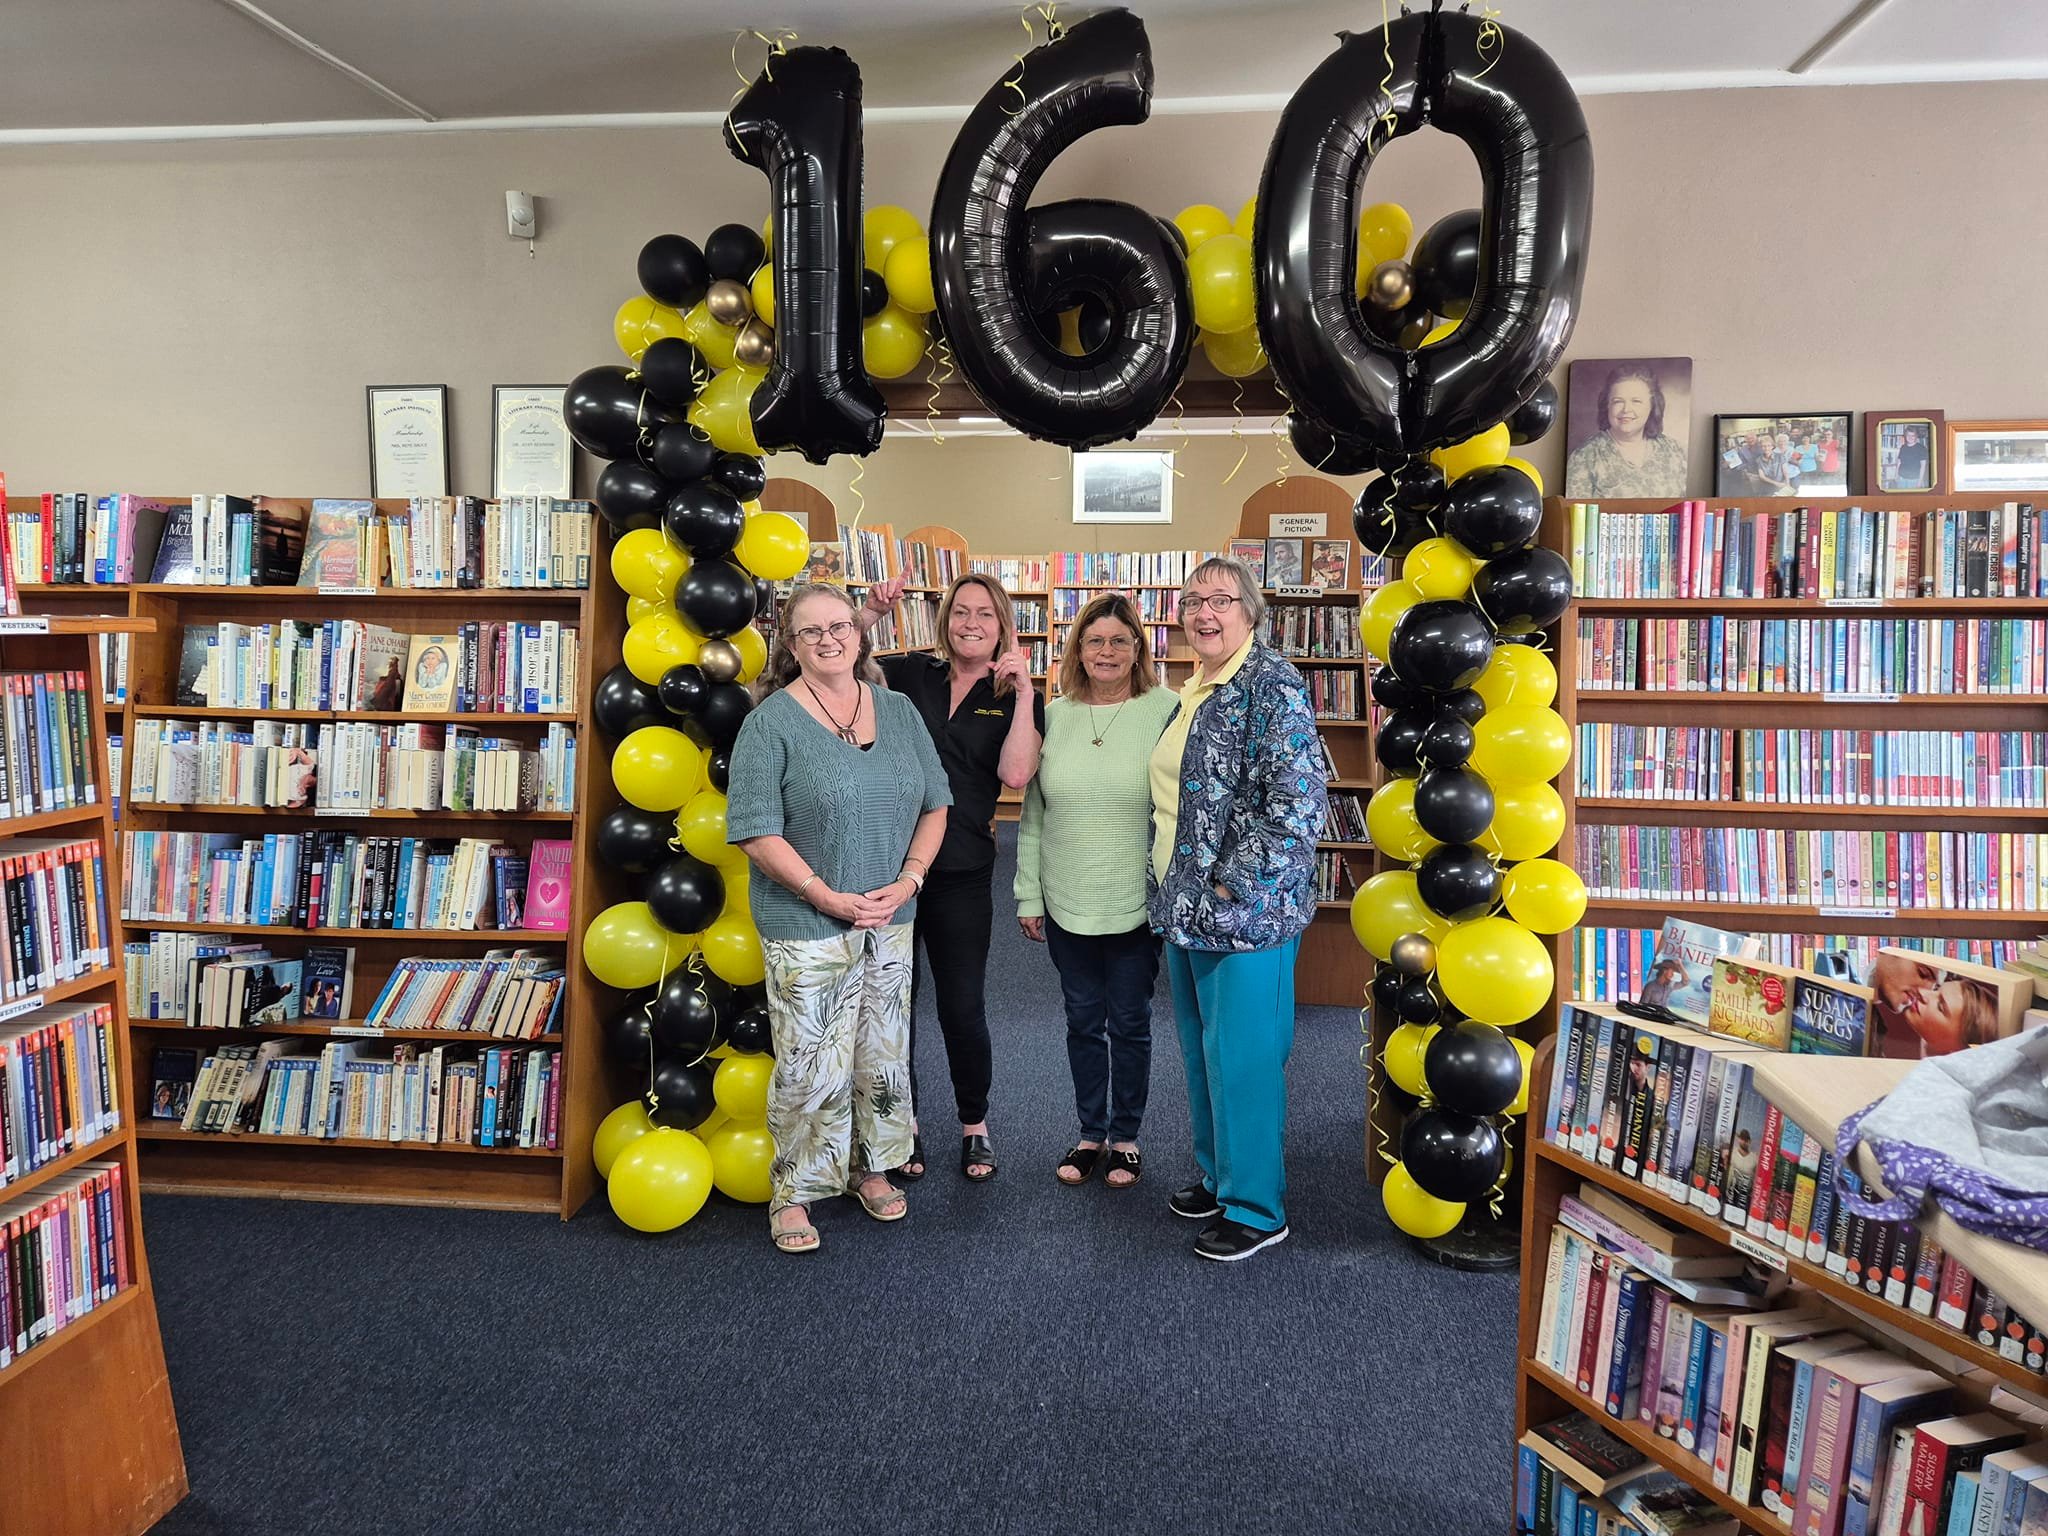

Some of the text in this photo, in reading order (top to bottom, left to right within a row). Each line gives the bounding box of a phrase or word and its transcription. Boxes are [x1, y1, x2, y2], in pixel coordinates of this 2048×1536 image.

[169, 524, 192, 536] McL
[178, 514, 192, 523] PAU
[2020, 534, 2029, 564] Conspiracy
[528, 657, 536, 685] JOSIE
[1668, 927, 1687, 943] B.J.
[1713, 1003, 1777, 1034] RICHARDS
[1715, 989, 1753, 1012] EMILIE
[1803, 988, 1856, 1021] SUSAN
[1804, 1010, 1855, 1041] WIGGS
[1566, 1038, 1579, 1079] DANIELS
[1579, 1044, 1592, 1086] DANIELS
[1593, 1024, 1611, 1094] DIANA PALMER
[1610, 1057, 1622, 1096] DANIELS
[1654, 1076, 1668, 1117] DANIELS
[1667, 1080, 1682, 1121] DANIELS
[1685, 1080, 1700, 1128] DANIELS
[1702, 1091, 1717, 1132] DANIELS
[1719, 1098, 1732, 1135] DANIELS
[1666, 1127, 1675, 1147] HEART
[1762, 1103, 1778, 1171] ANDACE CAMP
[1661, 1158, 1671, 1174] GOLD
[1819, 1152, 1833, 1185] OSTER
[1564, 1202, 1611, 1235] SARAH MORGAN
[1734, 1238, 1776, 1265] ROMANCE
[1852, 1219, 1865, 1259] OBSESSI
[1873, 1227, 1887, 1269] POSSESSI
[46, 1260, 54, 1293] DOLLAR
[1548, 1243, 1560, 1284] LAURENS
[1560, 1251, 1574, 1293] LAURENS
[1577, 1258, 1588, 1302] LAURENS
[1788, 1384, 1804, 1462] LINDA LAEL MILLER
[1812, 1396, 1841, 1480] DEBBIE MACOMBER
[1856, 1418, 1867, 1465] MACOMBER
[1865, 1432, 1876, 1461] DEBBIE
[1914, 1442, 1927, 1491] MALLERY
[1925, 1452, 1937, 1491] SUSAN
[1977, 1487, 1994, 1536] MAISEY
